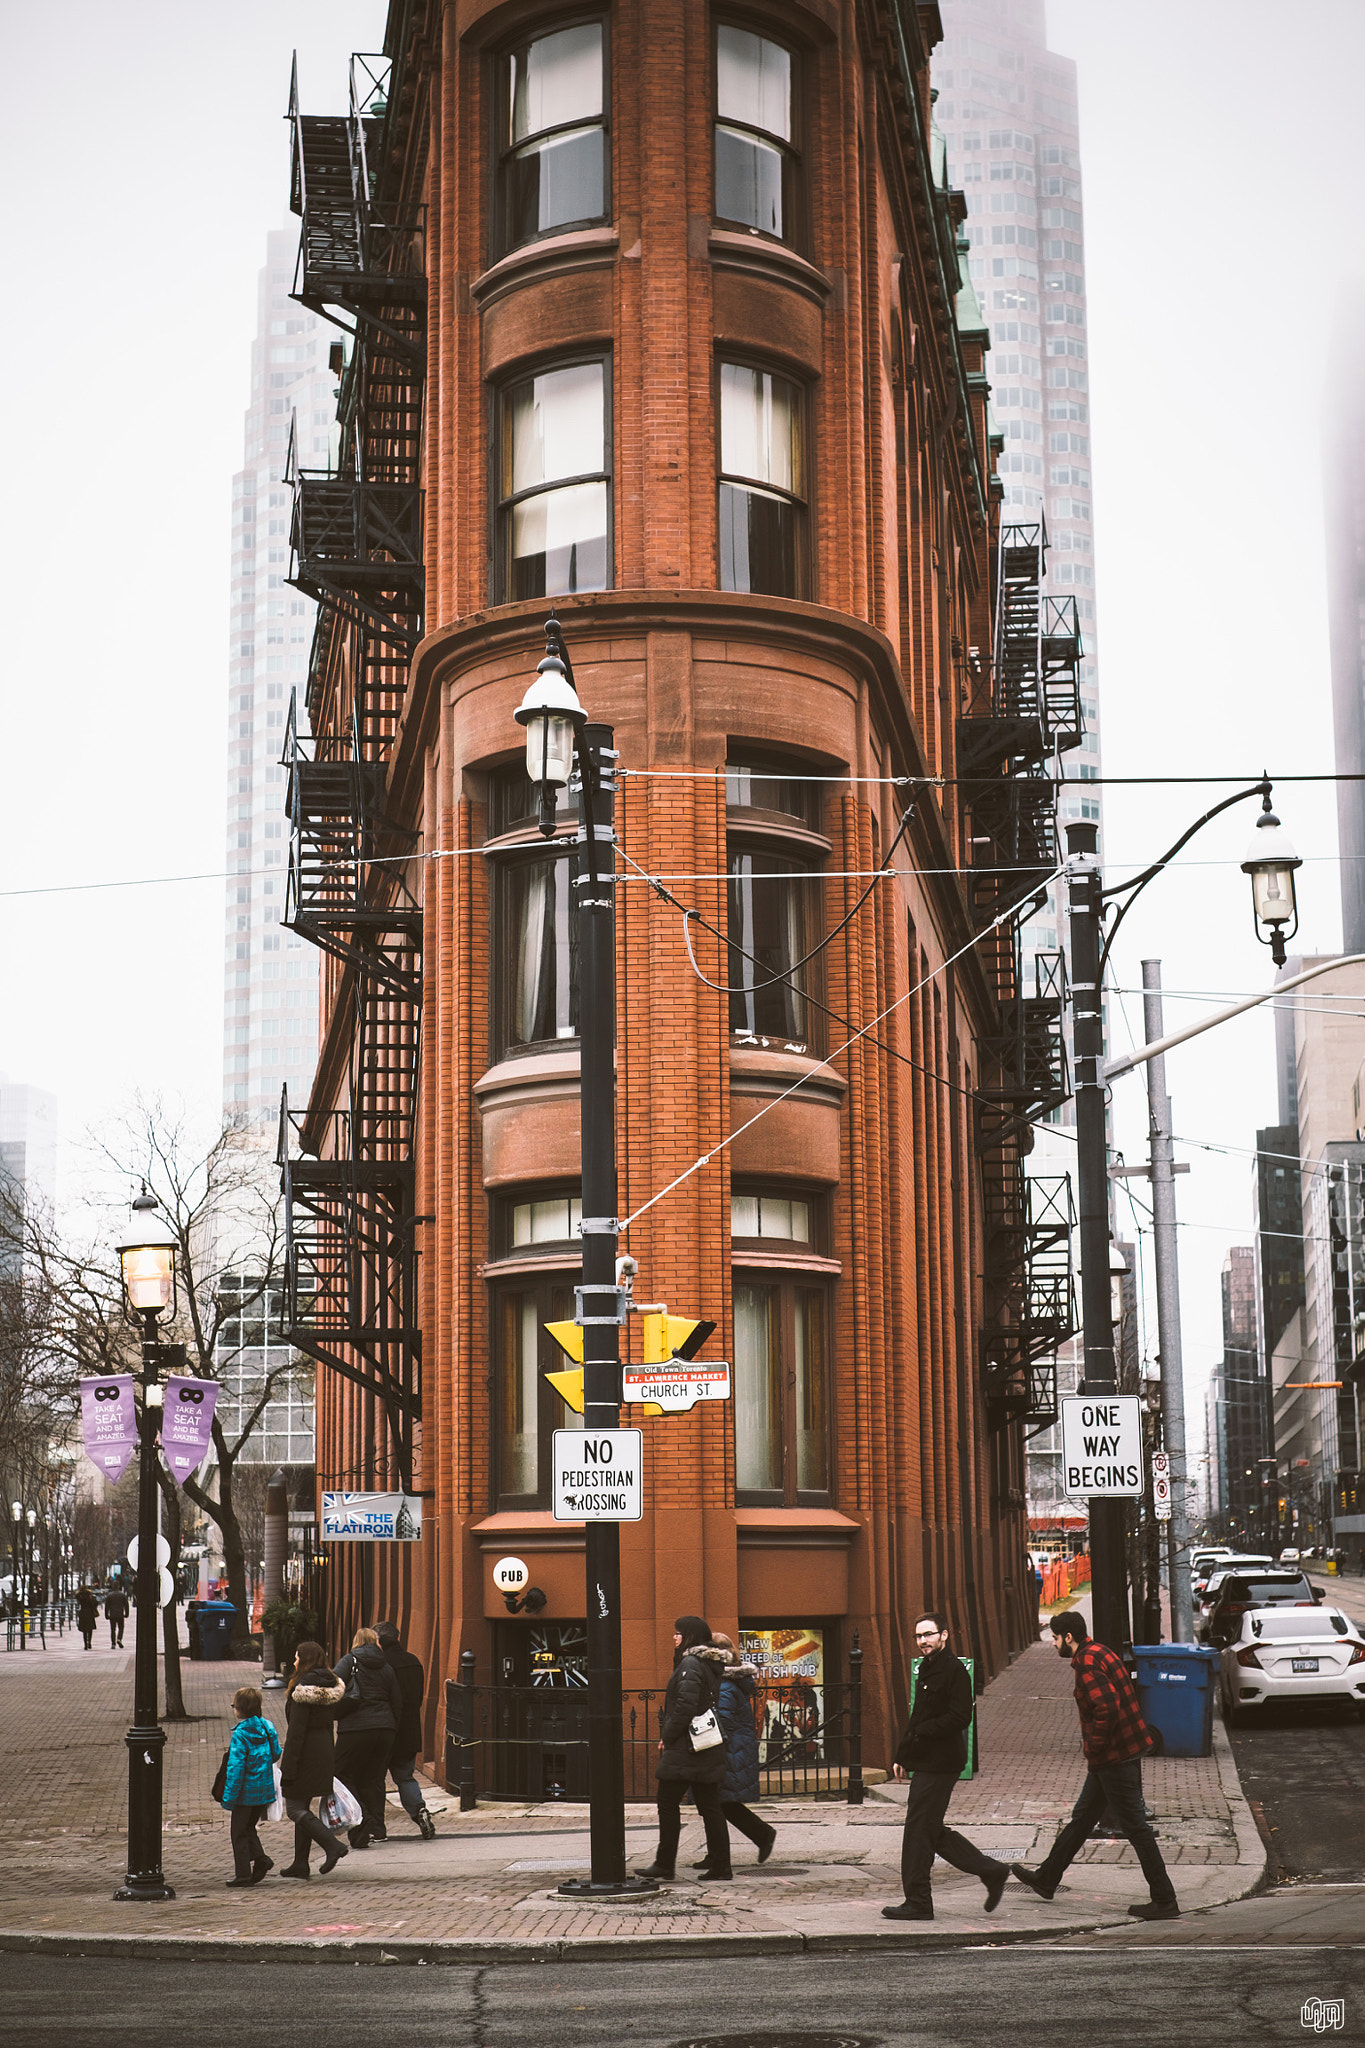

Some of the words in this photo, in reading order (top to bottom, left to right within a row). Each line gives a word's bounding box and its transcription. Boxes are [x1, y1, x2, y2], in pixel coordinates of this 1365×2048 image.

[629, 1375, 642, 1383] ST.
[644, 1374, 688, 1382] LAWRENCE
[641, 1384, 688, 1398] CHURCH
[696, 1383, 712, 1396] ST.
[94, 1405, 115, 1413] TAKE
[175, 1405, 196, 1414] TAKE
[95, 1413, 123, 1424] SEAT
[173, 1414, 202, 1426] SEAT
[1082, 1405, 1121, 1427] ONE
[96, 1425, 112, 1433] AND
[172, 1425, 188, 1434] AND
[584, 1439, 613, 1464] NO
[1083, 1435, 1121, 1457] WAY
[562, 1470, 633, 1487] PEDESTRIAN
[1068, 1465, 1139, 1488] BEGINS
[570, 1493, 627, 1511] ROSSING
[365, 1513, 393, 1523] THE
[326, 1524, 393, 1534] FLATIRON
[501, 1570, 523, 1582] PUB
[746, 1639, 769, 1649] NEW
[740, 1652, 770, 1663] BREED
[772, 1653, 784, 1662] OF
[792, 1664, 817, 1678] PUB
